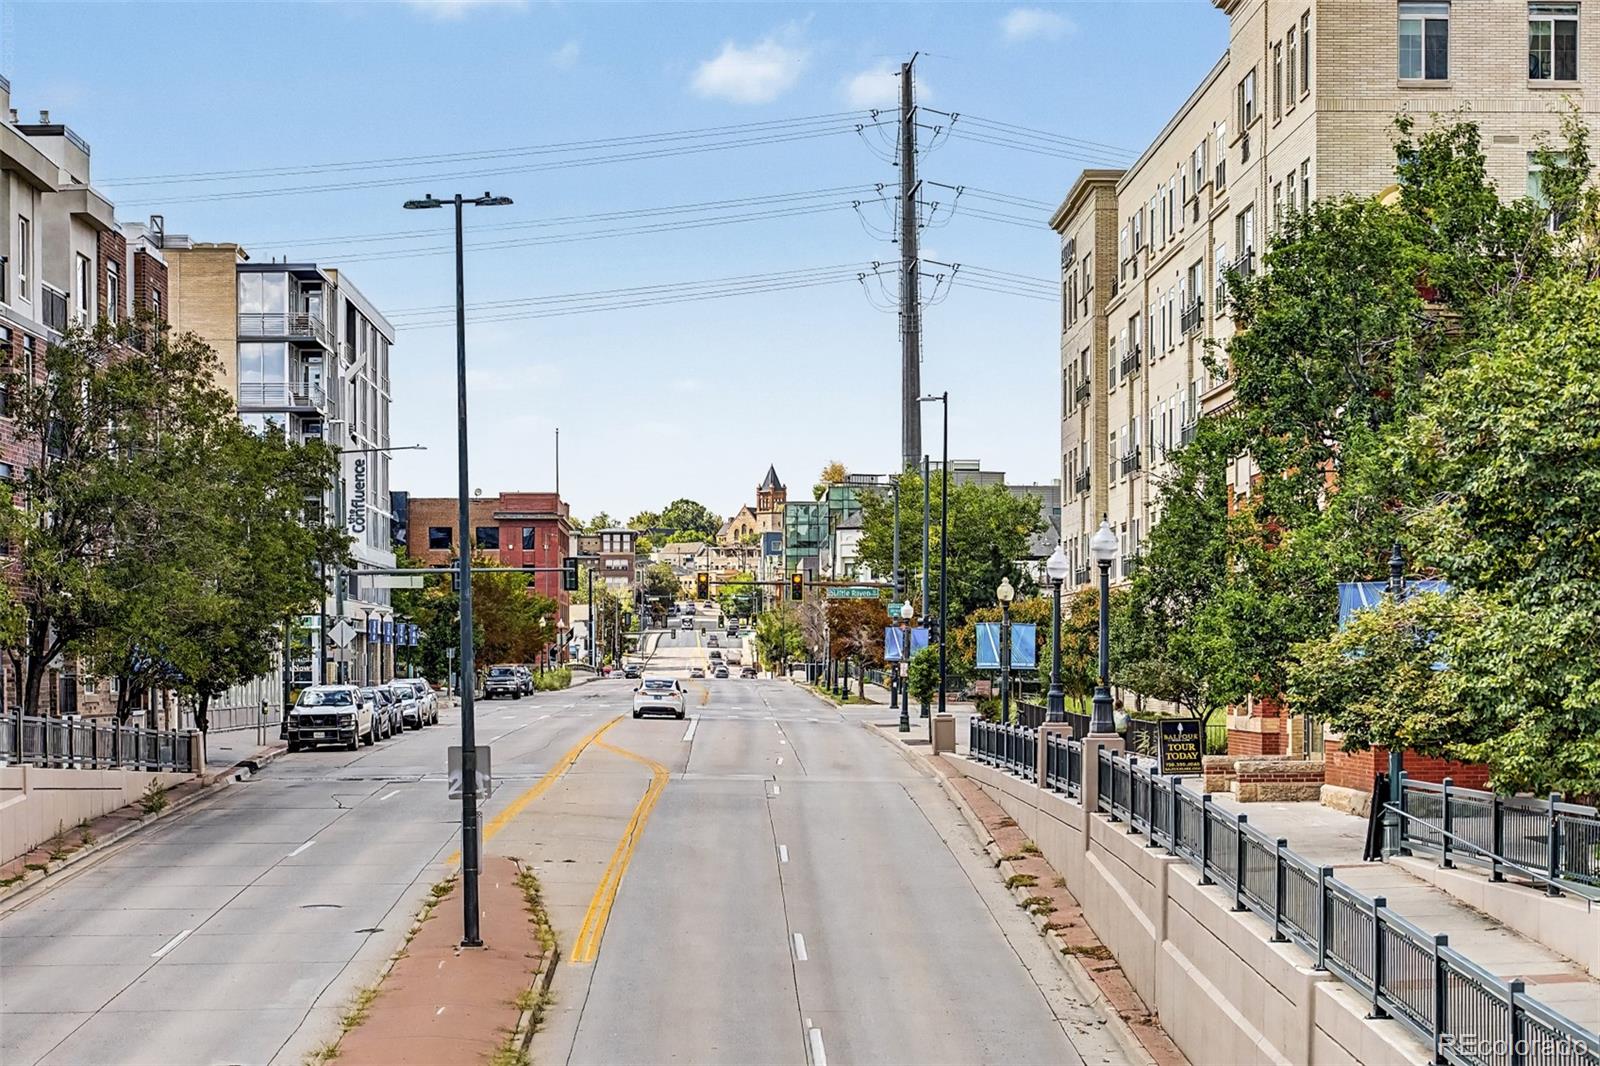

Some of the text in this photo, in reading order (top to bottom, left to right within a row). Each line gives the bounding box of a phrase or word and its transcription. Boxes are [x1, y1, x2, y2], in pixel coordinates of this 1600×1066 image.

[351, 459, 365, 533] Confluence
[348, 509, 356, 524] the
[833, 588, 850, 597] Little
[851, 589, 871, 597] Raven
[1168, 743, 1196, 751] TOUR
[1165, 752, 1199, 760] TODAY
